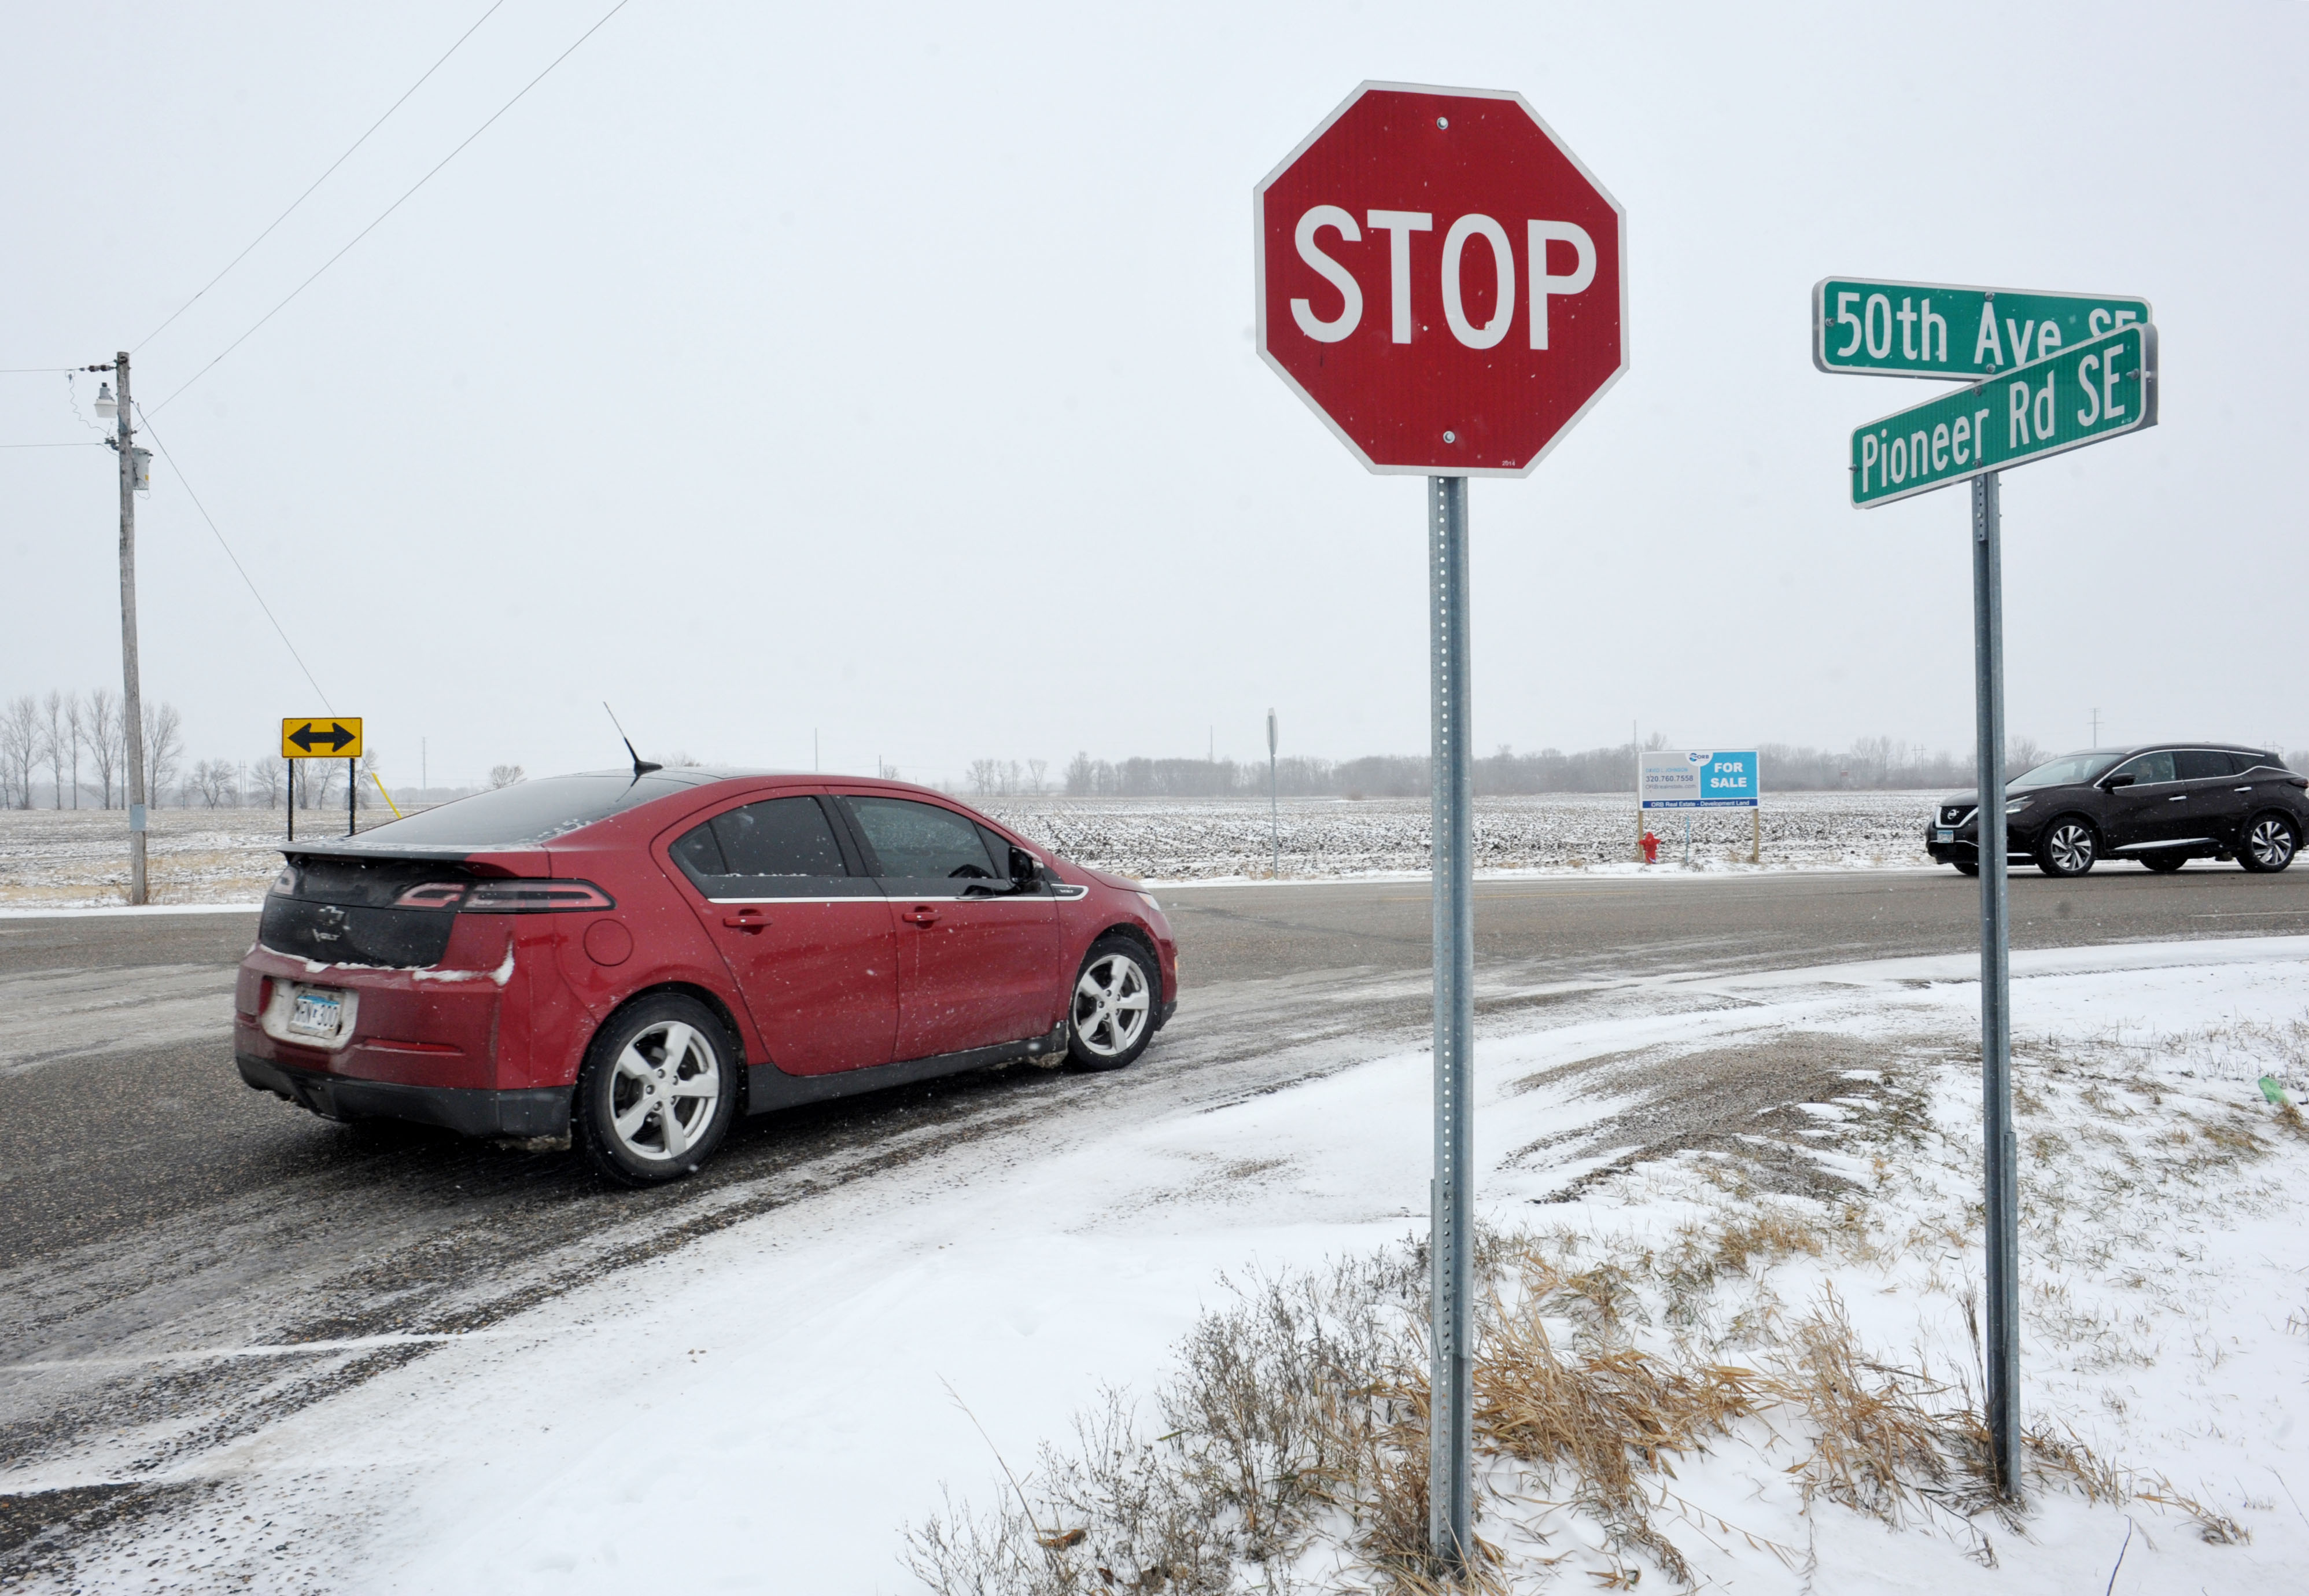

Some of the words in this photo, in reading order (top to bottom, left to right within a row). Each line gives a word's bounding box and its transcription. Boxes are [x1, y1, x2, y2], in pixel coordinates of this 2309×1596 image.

[1290, 204, 1596, 351] STOP
[1836, 291, 1947, 362] 50th
[1974, 301, 2061, 366] Ave
[1862, 408, 1989, 493] Pioneer
[2009, 370, 2055, 449] Rd
[2078, 343, 2125, 426] SE
[1710, 777, 1747, 788] SALE
[1714, 762, 1743, 773] FOR
